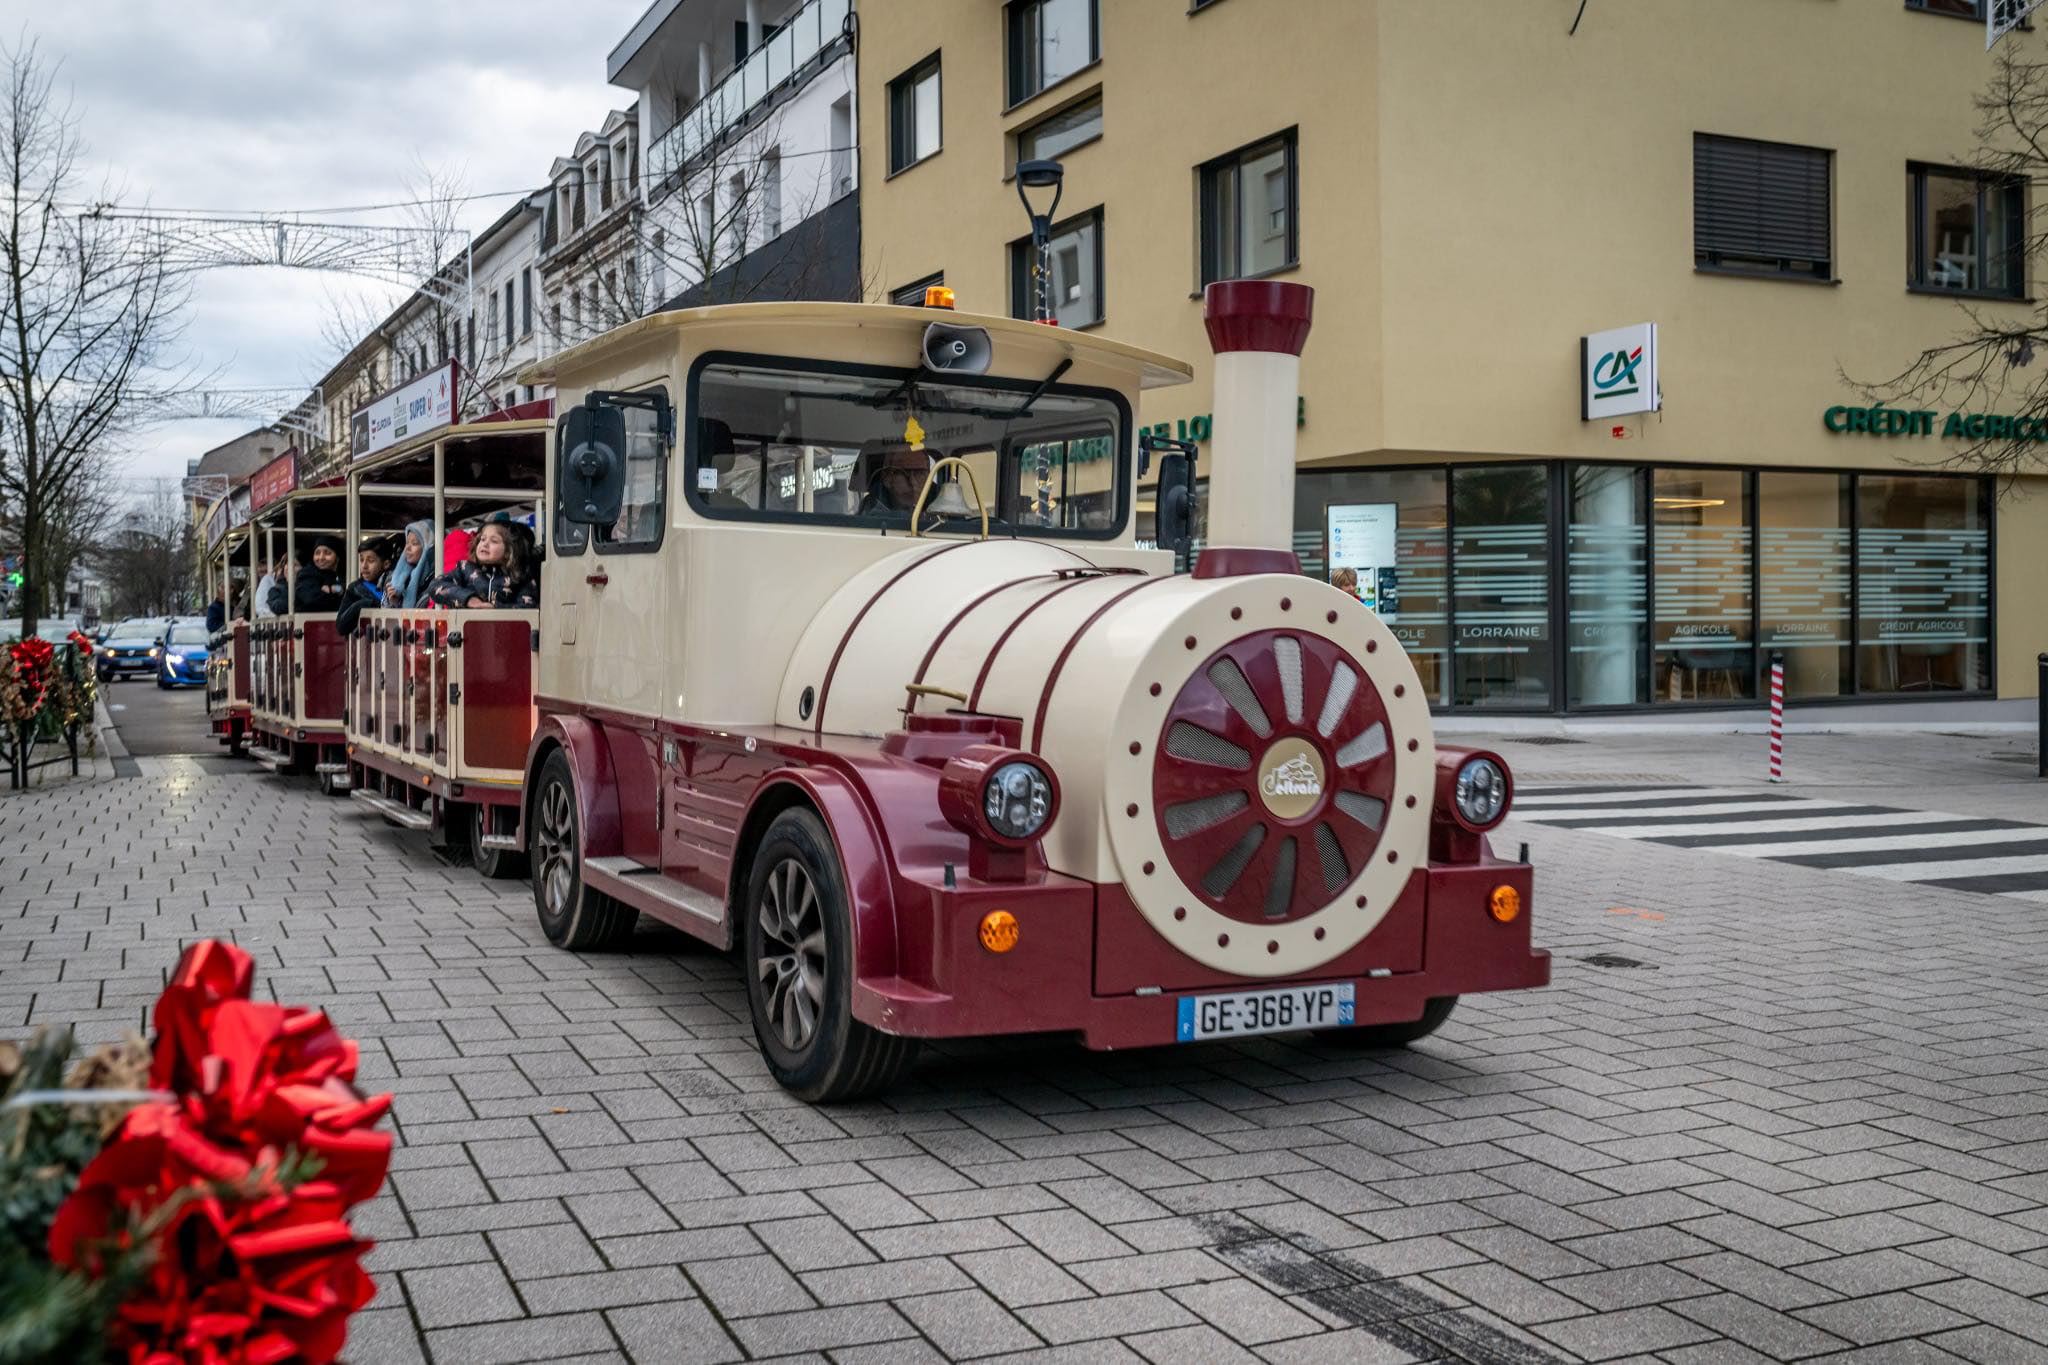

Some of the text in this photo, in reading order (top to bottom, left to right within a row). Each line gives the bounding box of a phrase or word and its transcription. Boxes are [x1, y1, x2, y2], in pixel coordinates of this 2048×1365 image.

[409, 396, 427, 421] SUPER
[1824, 402, 1938, 436] CRÉDIT
[1462, 626, 1540, 638] LORRAINE
[1674, 624, 1730, 635] AGRICOLE
[1776, 623, 1832, 634] LORRAINE
[1880, 619, 1965, 632] CRÉDIT AGRICOLE
[1201, 990, 1333, 1034] GE-368-YP
